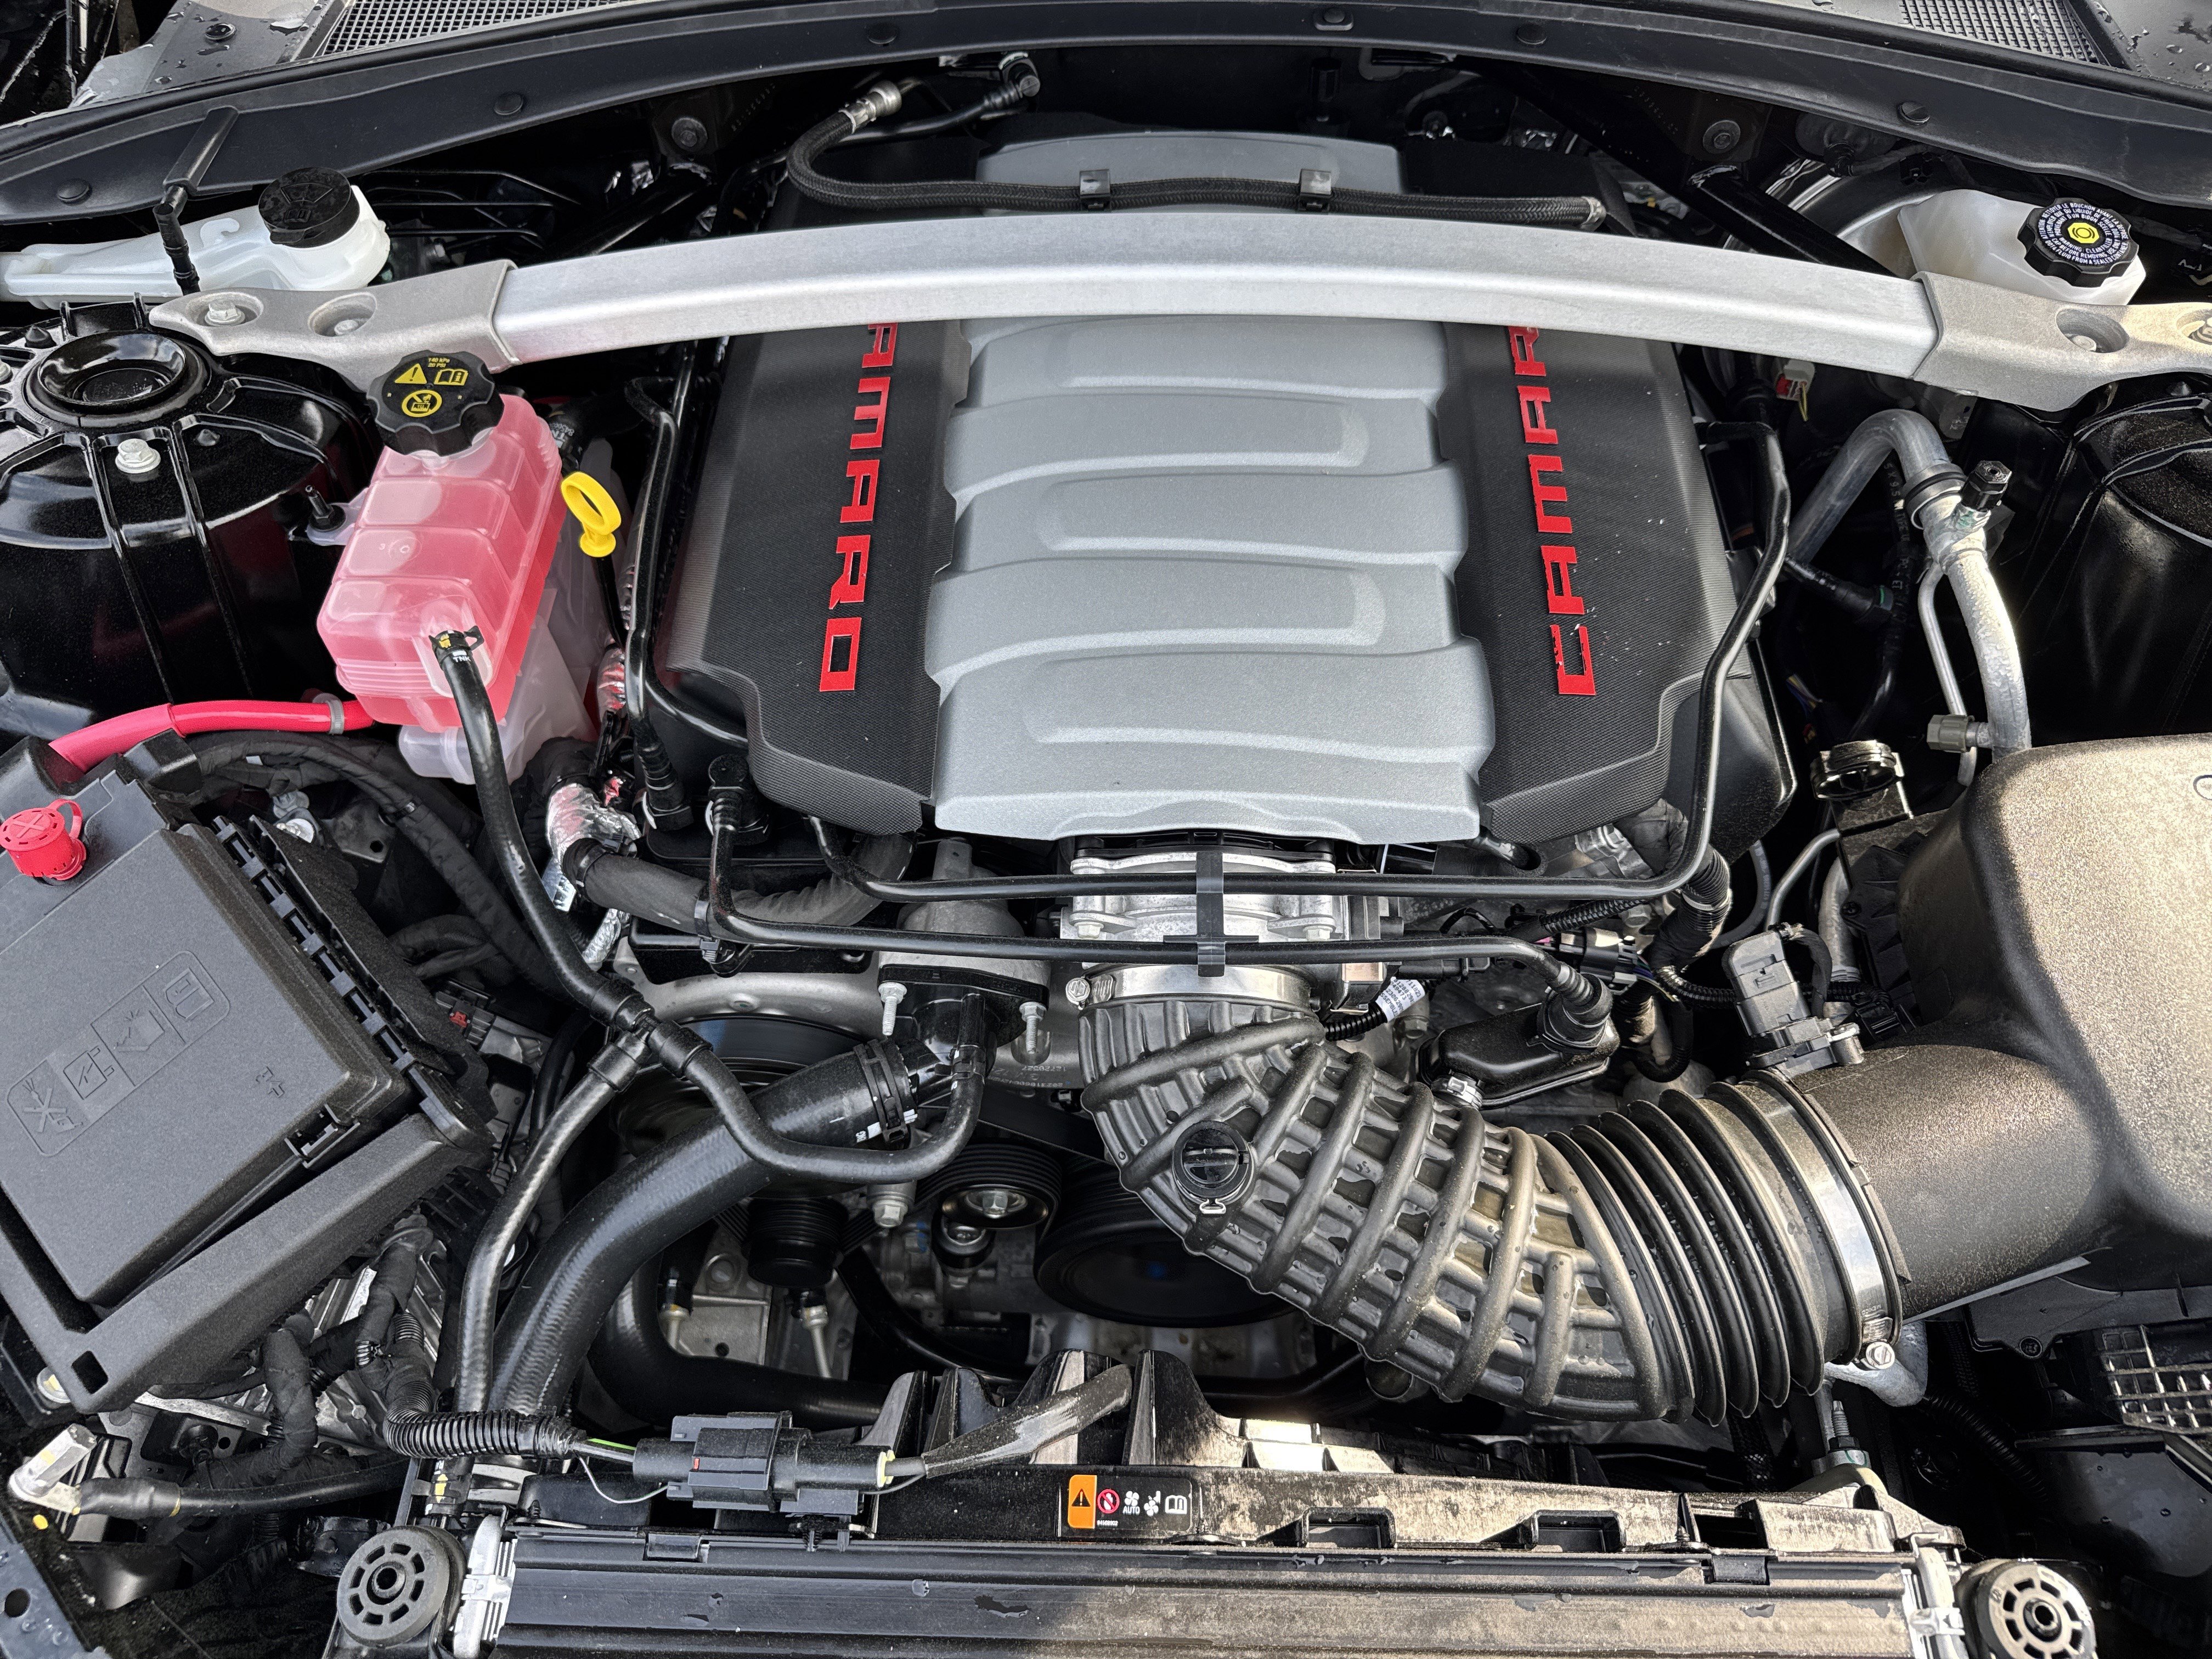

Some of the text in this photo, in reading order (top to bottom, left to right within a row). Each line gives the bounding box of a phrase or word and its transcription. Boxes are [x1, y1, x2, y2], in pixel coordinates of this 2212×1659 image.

[2069, 202, 2096, 211] BOUCHON
[2096, 208, 2114, 219] AVANT
[2081, 213, 2098, 223] BIDON
[2100, 217, 2116, 228] FREIN
[2059, 244, 2080, 257] BEFORE
[2055, 249, 2072, 259] FLUID
[2071, 255, 2089, 264] FROM
[2092, 256, 2113, 265] SEALED
[1122, 1505, 1141, 1515] AUTO
